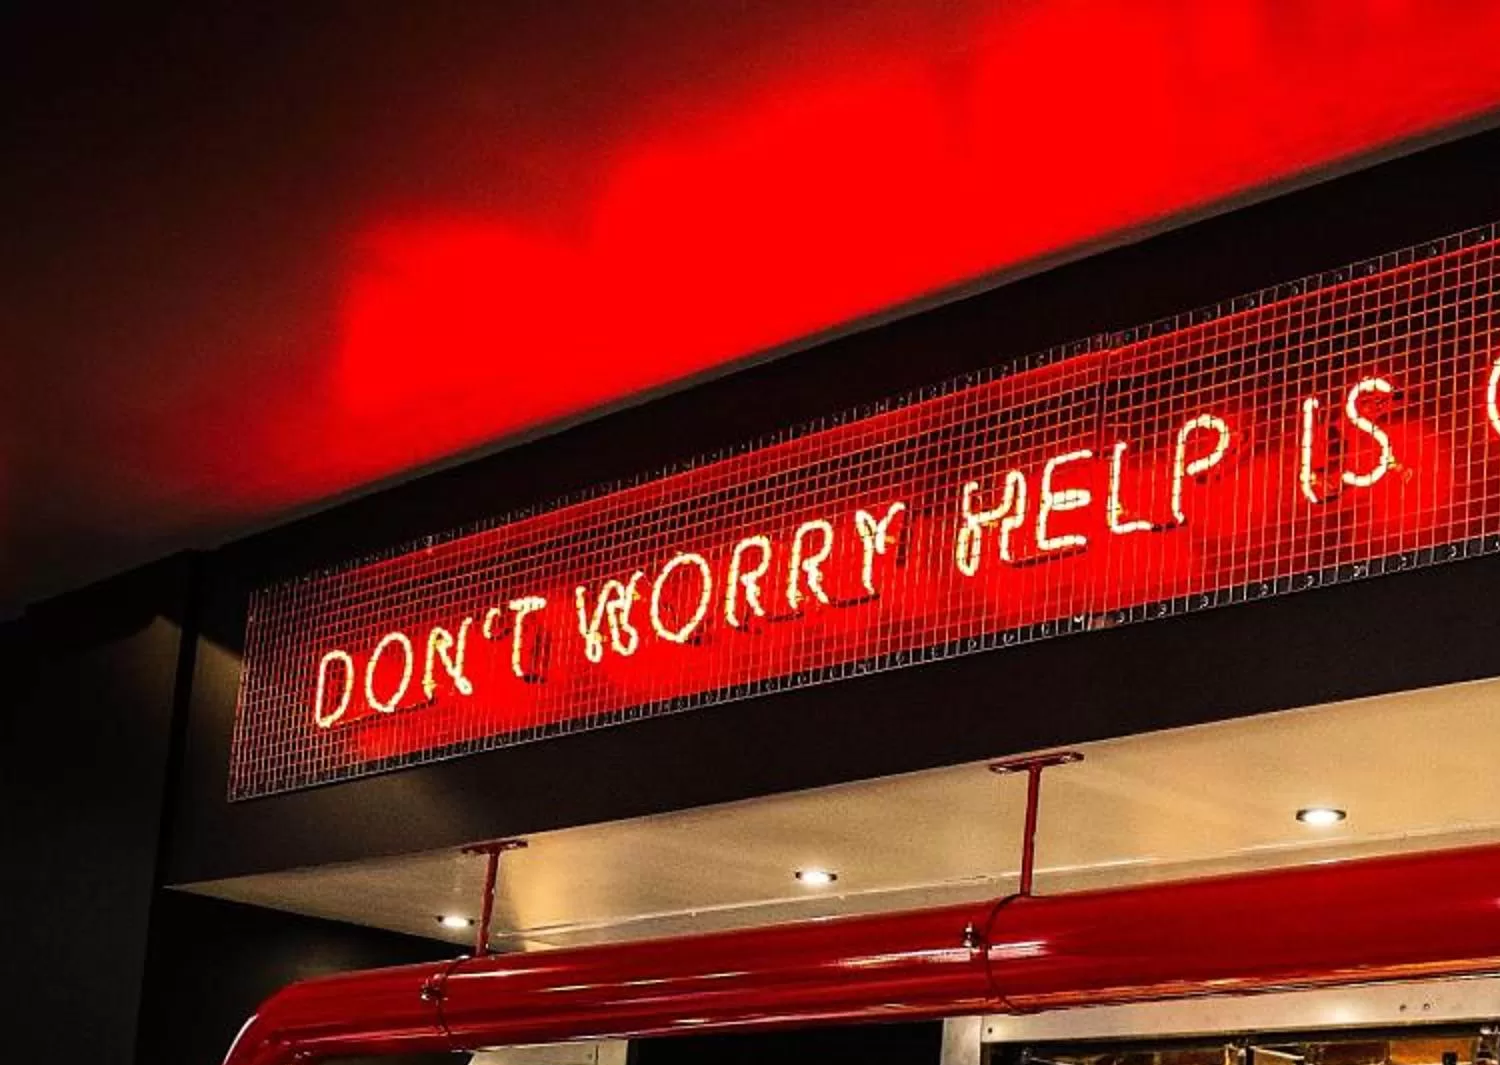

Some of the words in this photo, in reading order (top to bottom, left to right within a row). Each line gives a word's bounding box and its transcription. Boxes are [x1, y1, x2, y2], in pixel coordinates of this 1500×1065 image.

[314, 596, 545, 728] DON'T
[575, 501, 905, 662] WORRY
[954, 413, 1230, 577] HELP
[1299, 377, 1394, 503] IS
